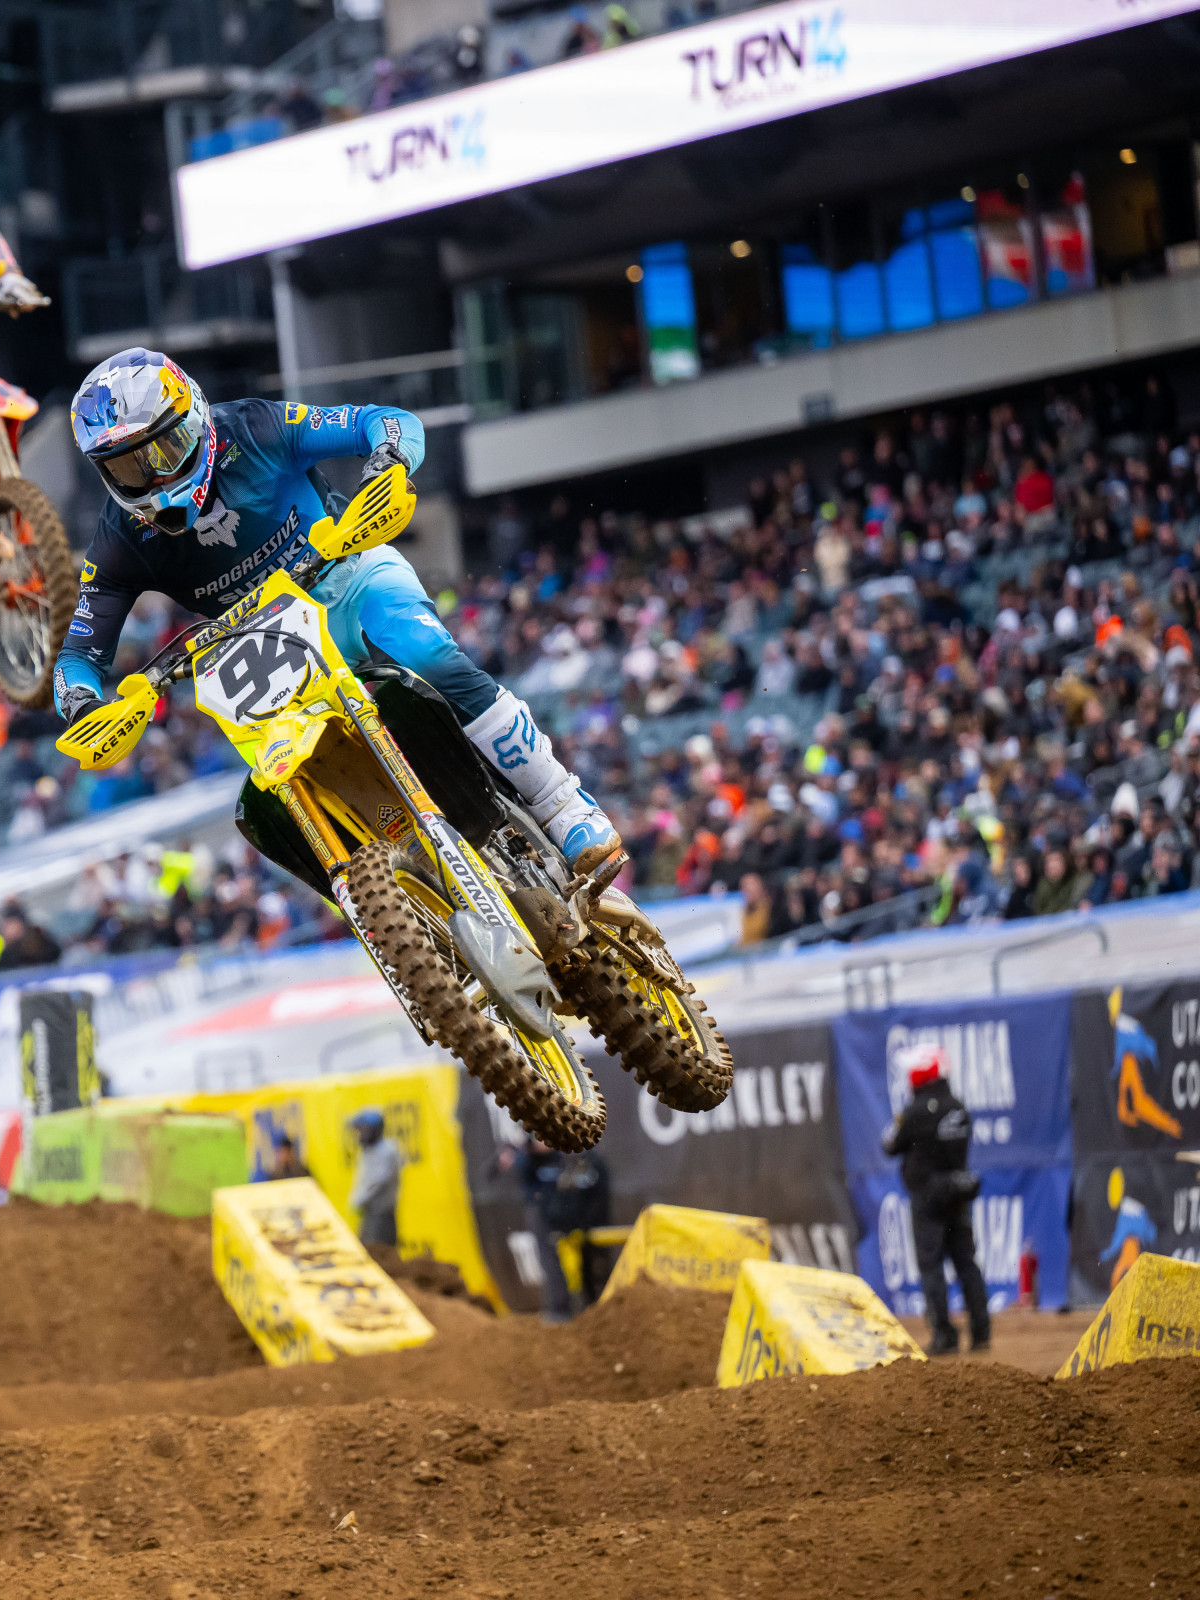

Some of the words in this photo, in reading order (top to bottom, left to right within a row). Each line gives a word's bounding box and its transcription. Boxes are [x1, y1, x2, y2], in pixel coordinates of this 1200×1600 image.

[194, 508, 300, 599] PROGRESSIVE
[341, 508, 401, 554] ACERBIS
[218, 532, 309, 605] SUZUKI
[194, 585, 265, 649] RENTHA
[219, 617, 309, 723] 94
[264, 747, 294, 772] DIXXON
[378, 808, 403, 830] DUBYA
[443, 849, 502, 928] DUNLOP
[1171, 999, 1200, 1049] UT
[1136, 1313, 1200, 1351] Inst
